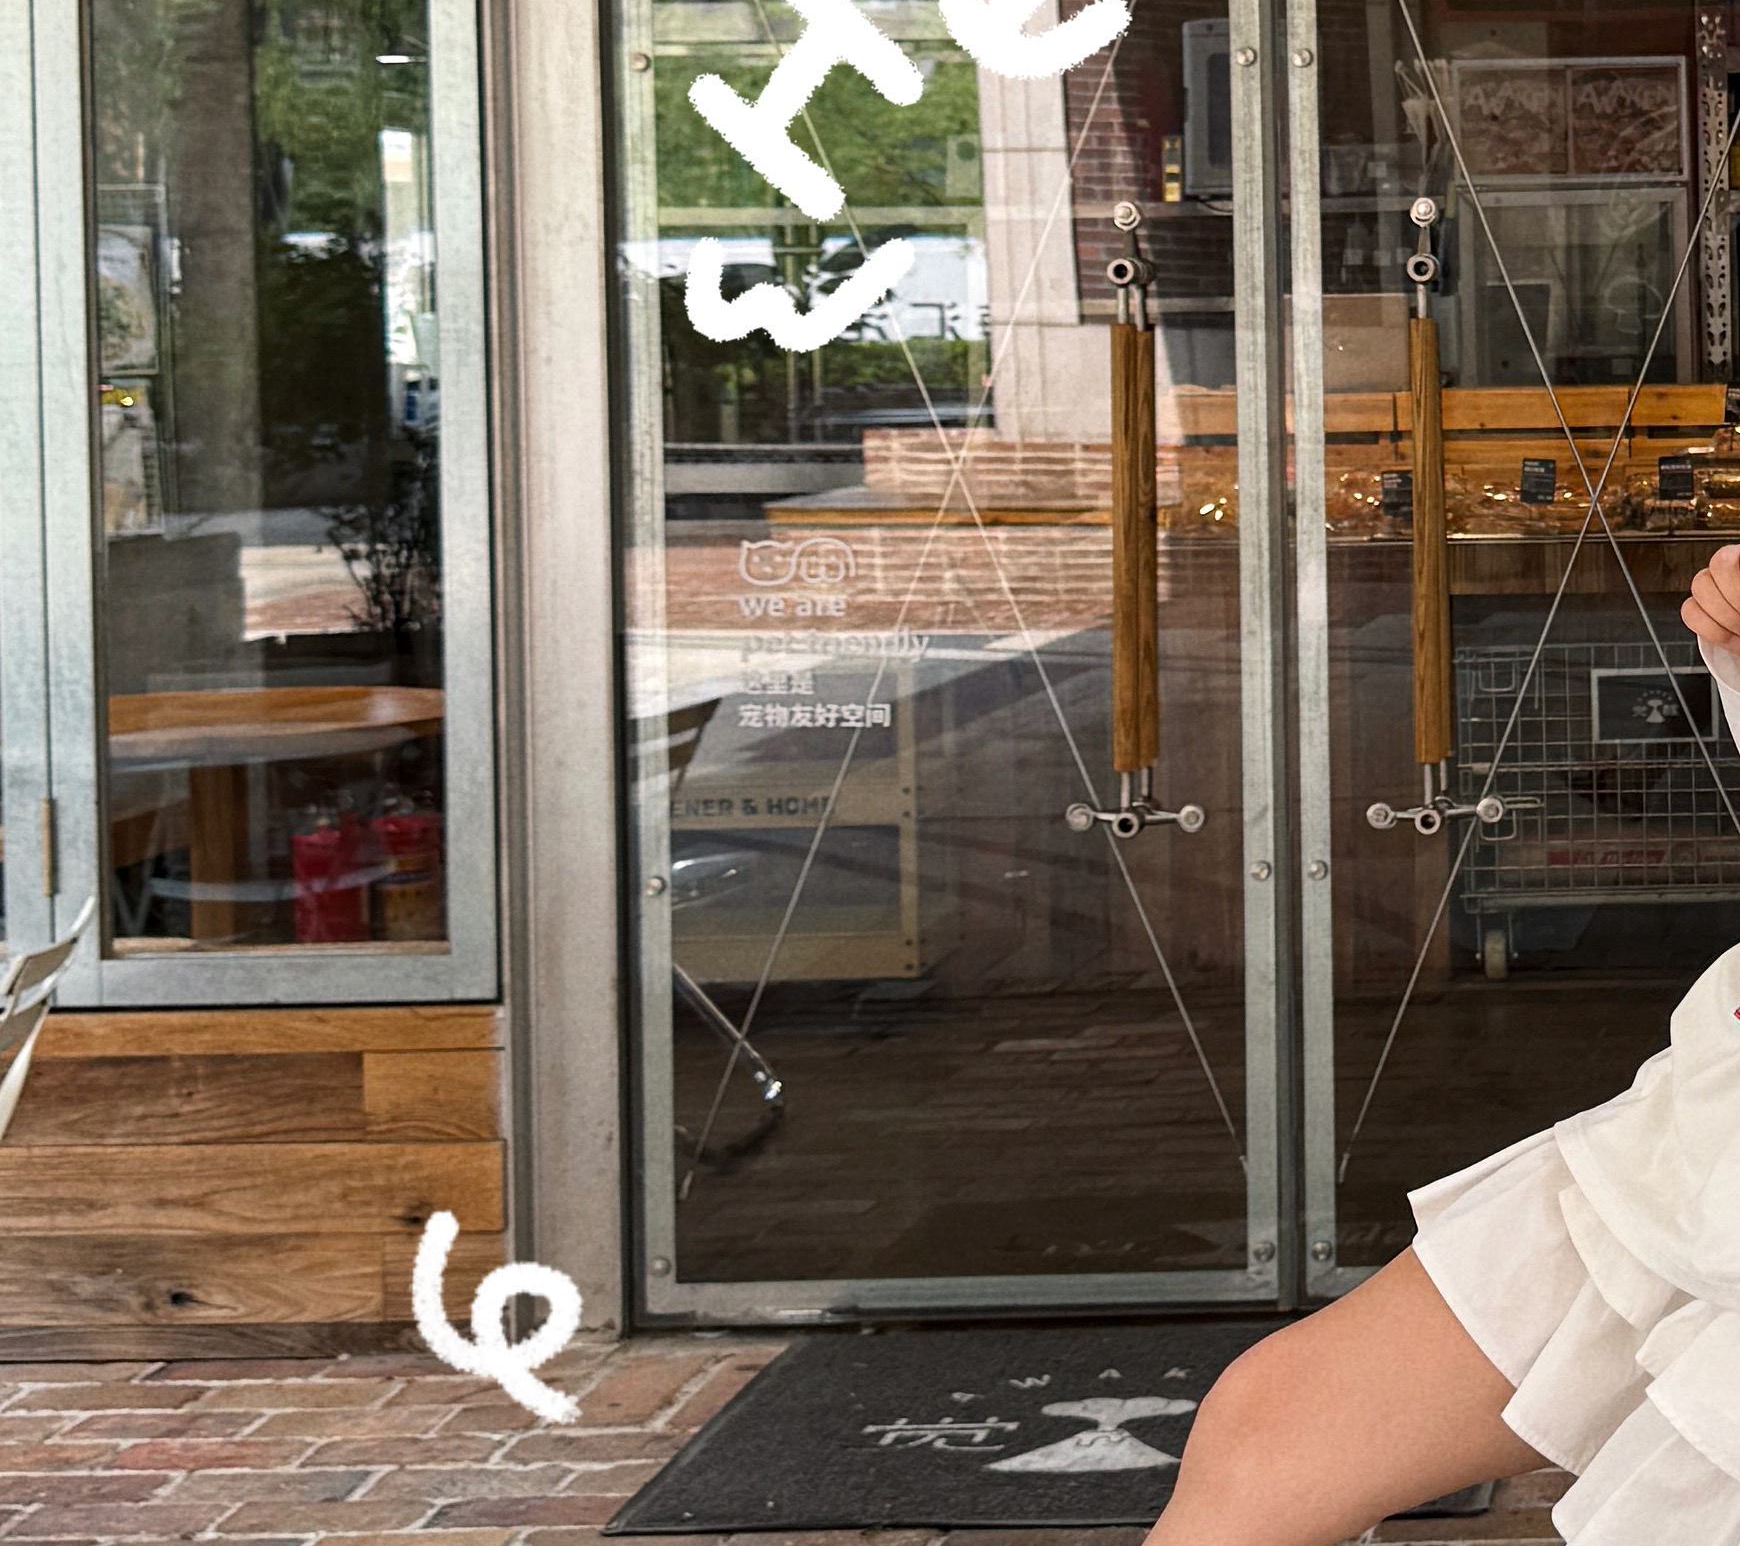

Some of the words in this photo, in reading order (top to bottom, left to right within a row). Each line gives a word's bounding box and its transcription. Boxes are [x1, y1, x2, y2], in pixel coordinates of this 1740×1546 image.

[738, 703, 892, 729] 宠物友好空间
